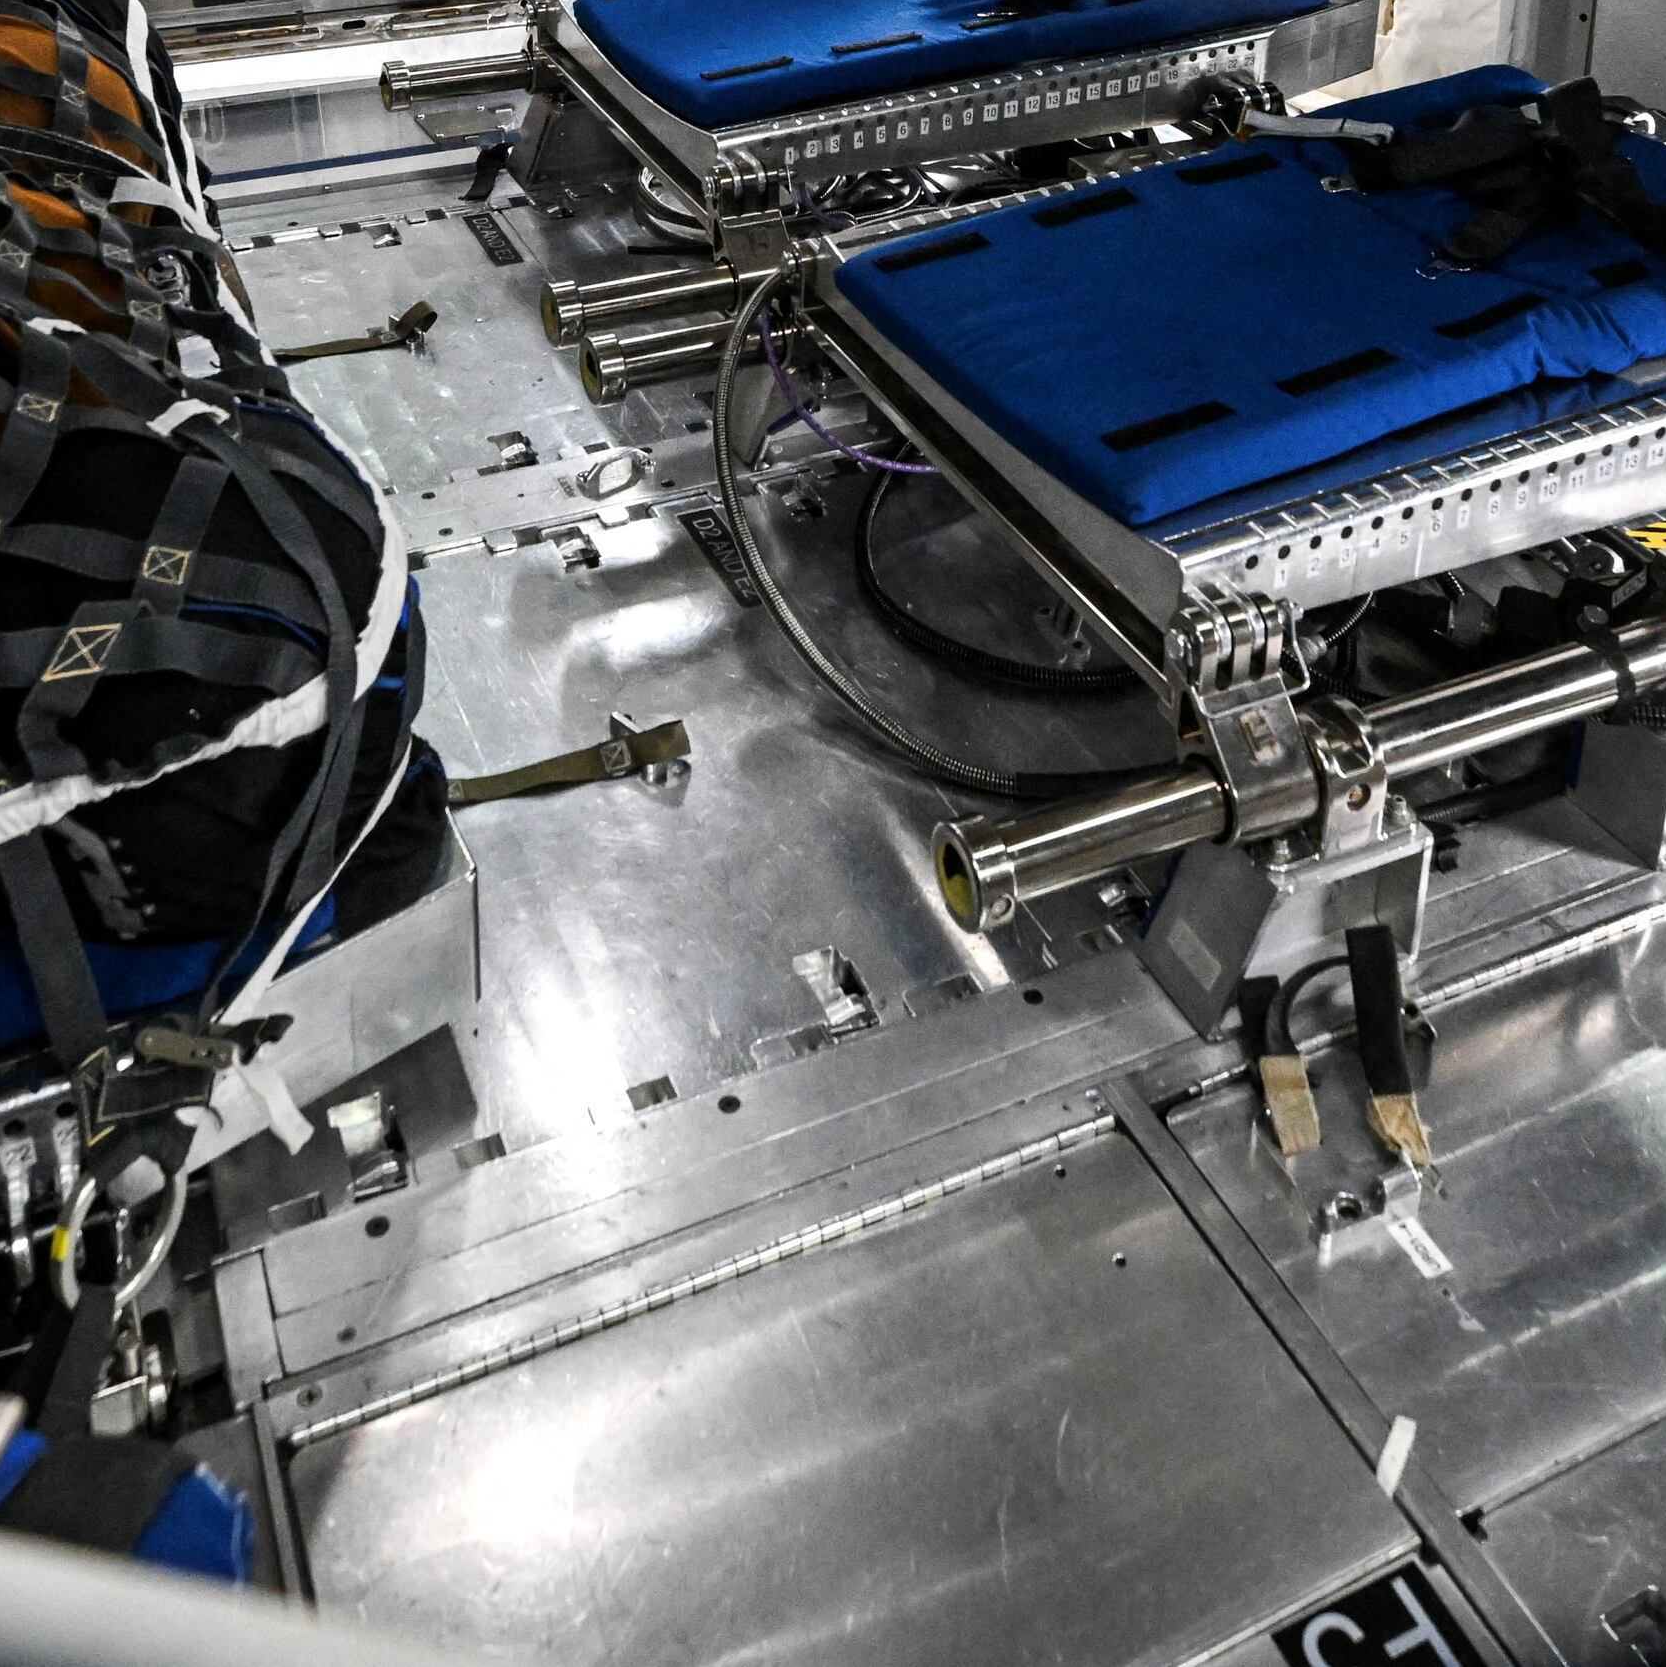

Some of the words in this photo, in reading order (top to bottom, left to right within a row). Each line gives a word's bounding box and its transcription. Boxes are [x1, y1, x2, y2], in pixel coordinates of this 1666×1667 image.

[985, 107, 997, 118] 10
[1006, 104, 1017, 114] 11
[1028, 99, 1039, 109] 12
[1048, 95, 1058, 105] 13
[1069, 91, 1079, 101] 14
[1089, 87, 1100, 97] 15
[1109, 83, 1119, 93] 16
[1129, 79, 1139, 89] 17
[1148, 73, 1158, 83] 18
[1168, 69, 1178, 79] 19
[1543, 481, 1557, 496] 10
[1571, 473, 1584, 486] 11
[1599, 462, 1613, 476] 12
[1625, 455, 1638, 469] 13
[1651, 446, 1664, 459] 14
[693, 517, 722, 539] D2
[707, 541, 745, 573] AND
